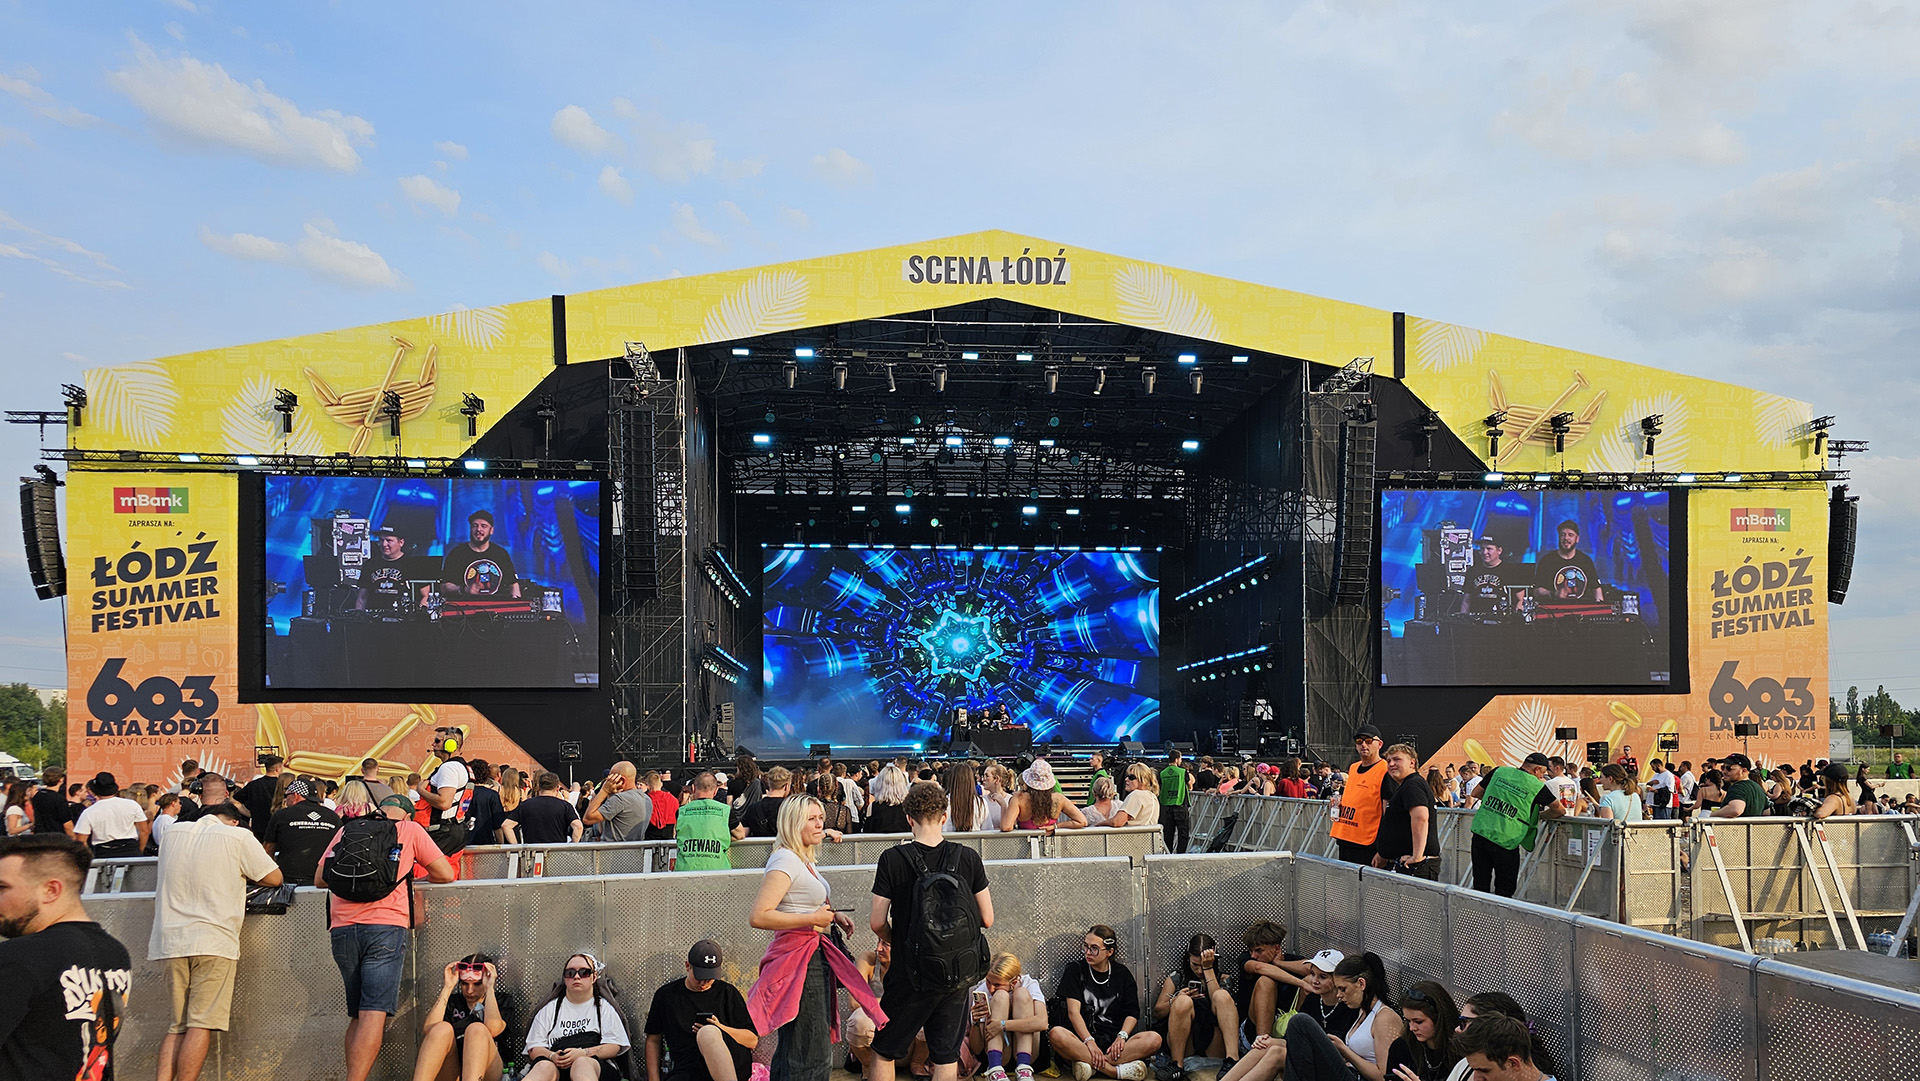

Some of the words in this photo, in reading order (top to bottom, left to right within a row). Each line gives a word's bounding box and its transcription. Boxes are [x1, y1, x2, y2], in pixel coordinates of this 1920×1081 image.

[908, 255, 993, 284] SCENA
[1001, 248, 1066, 285] ŁÓDŹ
[120, 494, 183, 507] mBank
[1735, 514, 1786, 526] mBank
[91, 531, 219, 587] ŁÓDŹ
[1711, 547, 1814, 598] ŁÓDŹ
[92, 576, 219, 610] SUMMER
[1711, 588, 1814, 619] SUMMER
[91, 599, 220, 633] FESTIVAL
[1711, 608, 1815, 639] FESTIVAL
[87, 658, 219, 721] 603
[1709, 661, 1815, 718] 603
[86, 719, 142, 736] LATA
[146, 718, 219, 736] ŁODZI
[86, 738, 100, 747] EX
[107, 737, 173, 746] NAVICULA
[181, 736, 220, 745] NAVIS
[1786, 732, 1816, 740] NAVIS
[1485, 795, 1518, 818] STEWARD
[682, 838, 721, 853] STEWARD
[560, 1018, 591, 1029] NOBODY
